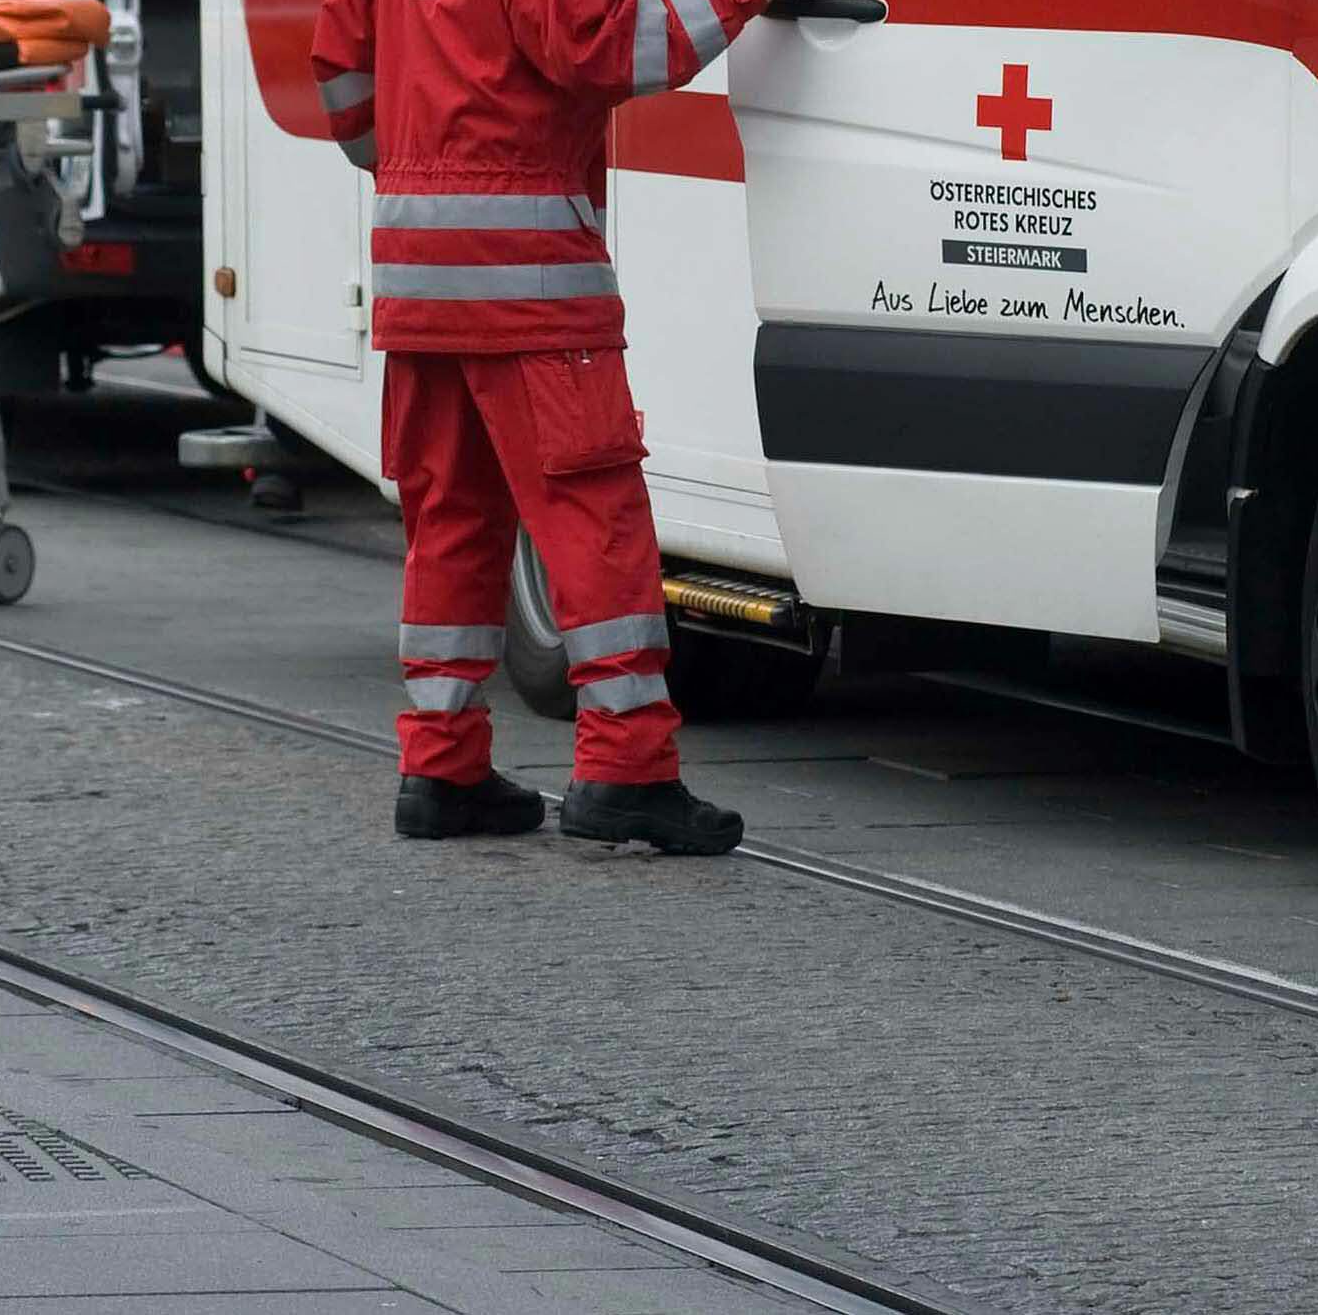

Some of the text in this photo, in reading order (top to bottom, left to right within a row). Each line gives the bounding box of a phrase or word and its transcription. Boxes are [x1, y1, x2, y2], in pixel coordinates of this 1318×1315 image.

[930, 180, 1097, 210] ÖSTERREICHISCHES
[954, 210, 1073, 236] ROTES KREUZ
[967, 245, 1062, 268] STEIERMARK
[871, 280, 1186, 329] Aus Liebe zum Menschen.
